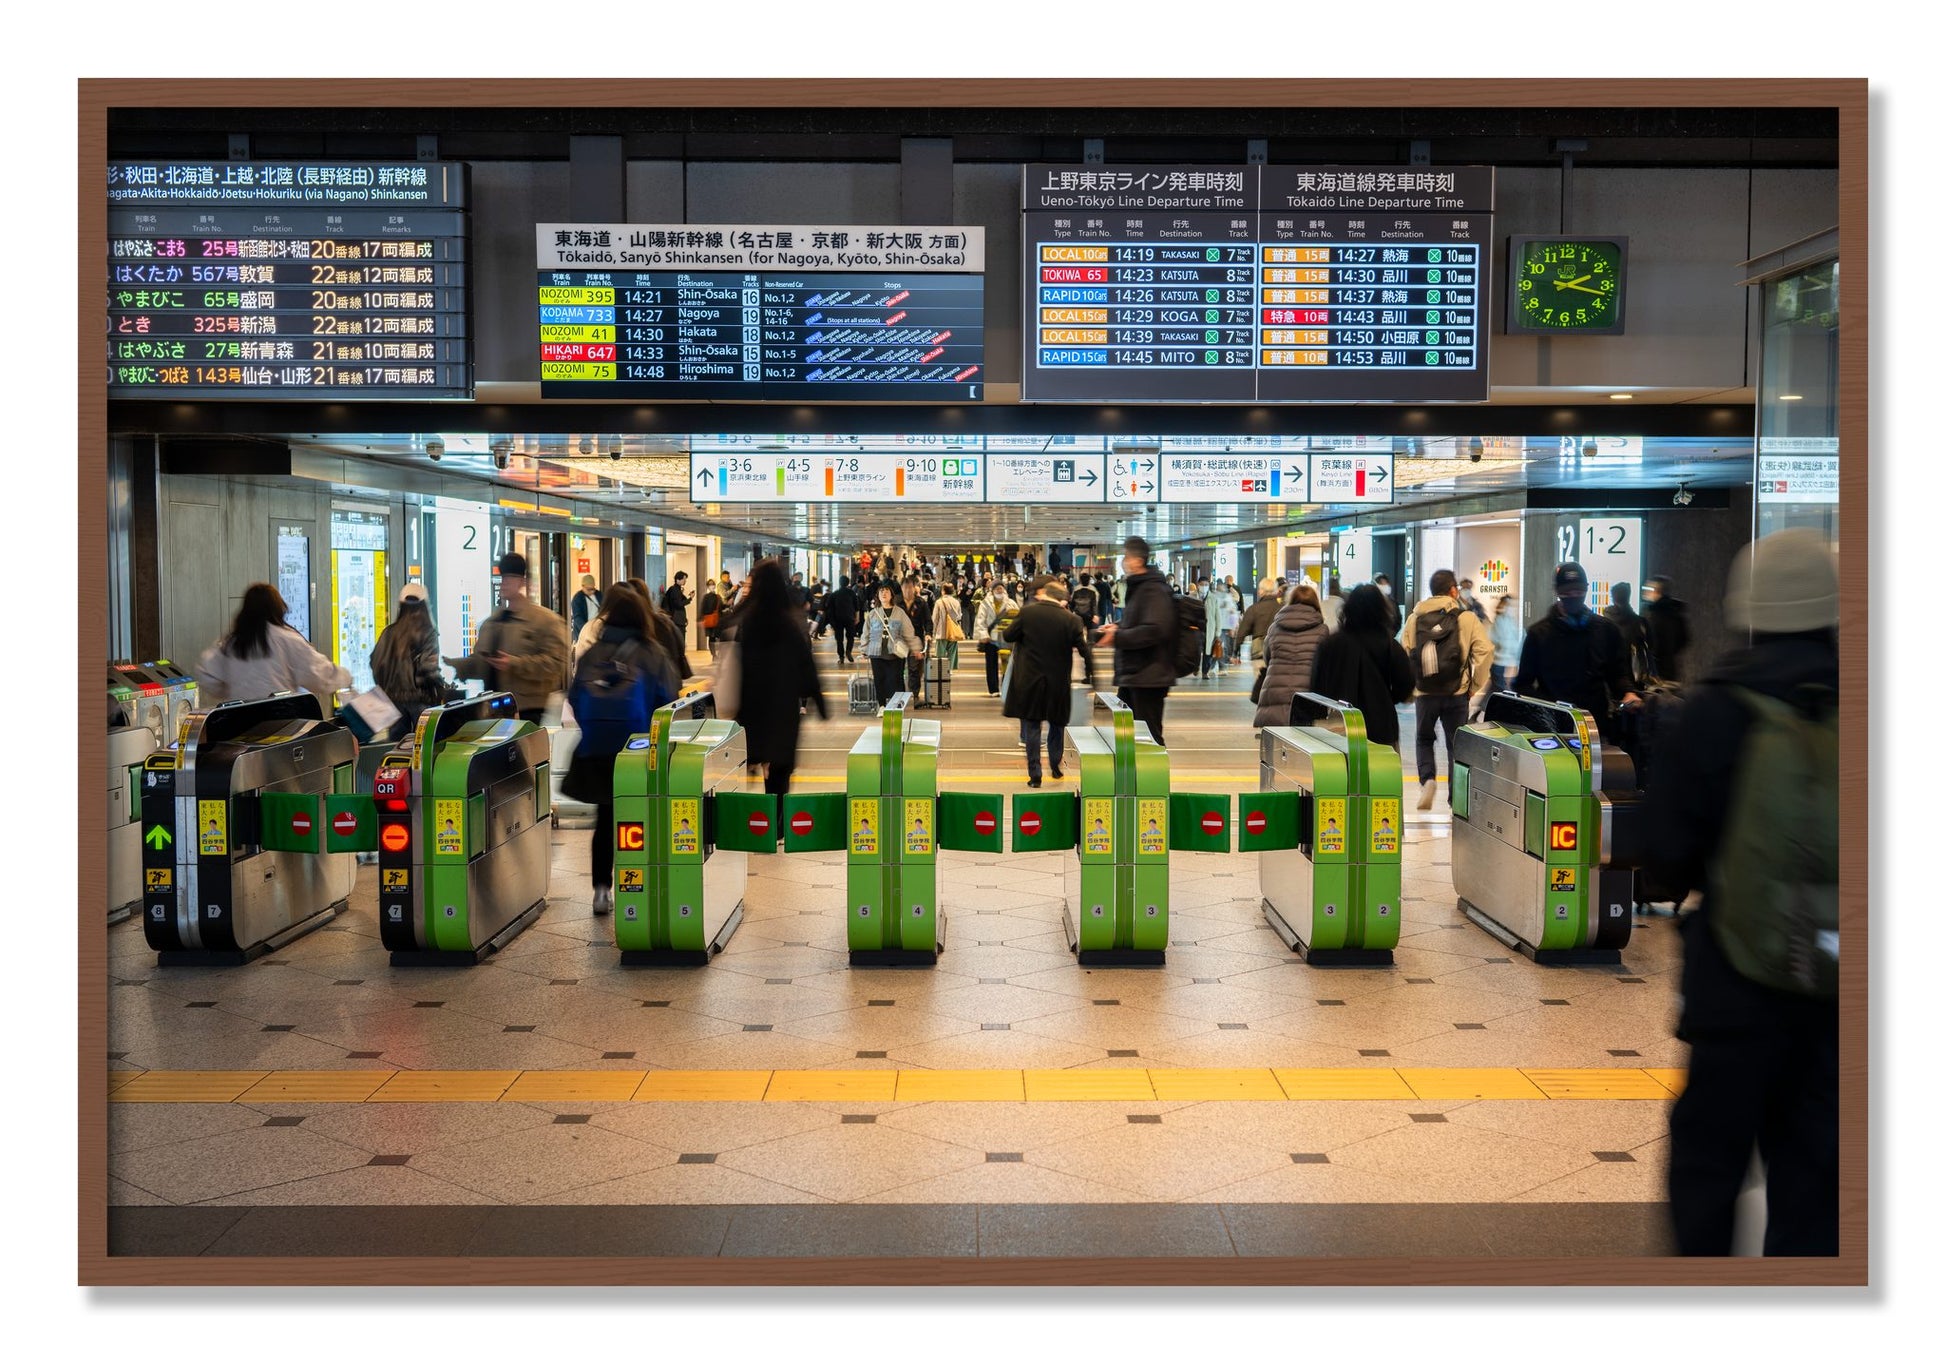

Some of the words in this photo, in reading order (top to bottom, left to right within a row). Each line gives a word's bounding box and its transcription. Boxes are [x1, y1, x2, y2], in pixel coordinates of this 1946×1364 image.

[1041, 171, 1243, 192] 上野東京ライン発車時刻
[1297, 173, 1454, 192] 東海道線発車時刻
[305, 189, 323, 201] (via
[326, 189, 368, 201] Nagano)
[371, 189, 427, 200] Shinkansen
[1041, 195, 1115, 209] Ueno-Tōkyō
[1119, 196, 1144, 207] Line
[1148, 196, 1210, 209] Departure
[1214, 196, 1244, 207] Time
[1287, 196, 1335, 207] Tōkaidō
[1339, 196, 1364, 207] Line
[1369, 196, 1430, 209] Departure
[1435, 197, 1464, 207] Time
[253, 225, 292, 233] Destination
[557, 251, 617, 264] Tōkaidō,
[620, 251, 661, 265] Sanyō
[665, 251, 743, 263] Shinkansen
[749, 252, 774, 265] (for
[778, 253, 833, 266] Nagoya,
[838, 252, 881, 266] Kyōto,
[885, 252, 965, 266] Shin-Ōsaka)
[1115, 249, 1154, 261] 14:19
[1161, 251, 1199, 259] TAKASAKI
[1272, 250, 1296, 262] 普通
[1337, 250, 1375, 262] 14:27
[1382, 250, 1409, 262] 熱海
[1560, 248, 1575, 258] 12
[1582, 252, 1587, 262] 1
[1594, 263, 1603, 272] 2
[115, 266, 183, 282] はくたか
[191, 265, 240, 282] 567号
[239, 265, 274, 283] 敦賀
[1044, 270, 1081, 280] TOKIWA
[1087, 270, 1101, 280] 65
[1115, 269, 1154, 282] 14:23
[1161, 271, 1199, 280] KATSUTA
[1337, 270, 1375, 282] 14:30
[1382, 270, 1407, 283] 品川
[1522, 280, 1532, 290] 9
[1601, 280, 1610, 290] 3
[117, 291, 185, 308] やまびこ
[204, 291, 240, 308] 65号
[240, 291, 275, 309] 盛岡
[541, 289, 583, 299] NOZOMI
[586, 290, 612, 303] 395
[625, 290, 661, 303] 14:21
[678, 289, 737, 299] Shin-Ōsaka
[765, 294, 795, 303] No.1,2
[1115, 290, 1154, 302] 14:26
[1161, 291, 1199, 301] KATSUTA
[1337, 291, 1374, 303] 14:37
[1382, 290, 1408, 303] 熱海
[542, 308, 583, 317] KODAMA
[587, 309, 613, 322] 733
[625, 309, 662, 322] 14:27
[678, 308, 720, 319] Nagoya
[1115, 310, 1154, 323] 14:29
[1161, 311, 1199, 322] KOGA
[1271, 311, 1296, 323] 特急
[1336, 311, 1374, 323] 14:43
[1382, 312, 1407, 324] 品川
[1560, 312, 1569, 322] 6
[118, 316, 151, 333] とき
[194, 316, 240, 333] 325号
[240, 315, 276, 334] 新潟
[542, 327, 584, 336] NOZOMI
[592, 328, 607, 340] 41
[625, 328, 664, 341] 14:30
[679, 327, 717, 337] Hakata
[1115, 331, 1153, 343] 14:39
[1161, 333, 1199, 341] TAKASAKI
[1270, 332, 1295, 344] 普通
[1336, 332, 1374, 344] 14:50
[1381, 331, 1419, 344] 小田原
[118, 341, 186, 358] はやぶさ
[205, 342, 240, 358] 27号
[240, 341, 294, 360] 新青森
[544, 345, 583, 354] HIKARI
[587, 346, 613, 359] 647
[626, 347, 664, 360] 14:33
[679, 345, 738, 356] Shin-Ōsaka
[765, 350, 796, 359] No.1-5
[1115, 351, 1153, 363] 14:45
[1161, 352, 1195, 362] MITO
[1336, 352, 1373, 364] 14:53
[1381, 352, 1406, 365] 品川
[196, 367, 241, 383] 143号
[543, 364, 584, 373] NOZOMI
[593, 365, 608, 377] 75
[626, 365, 664, 378] 14:48
[679, 364, 734, 374] Hiroshima
[1321, 460, 1352, 469] 京葉線
[836, 474, 886, 482] 上野東京ライン
[943, 480, 974, 489] 新幹線
[463, 526, 477, 549] 2
[1345, 544, 1356, 559] 4
[1480, 585, 1508, 593] GRANSTA
[377, 783, 395, 795] QR
[619, 825, 644, 848] IC
[1553, 826, 1575, 848] IC
[155, 906, 161, 915] 8
[211, 906, 217, 915] 7
[393, 906, 399, 915] 7
[446, 907, 453, 916] 6
[627, 907, 634, 916] 6
[682, 906, 688, 915] 5
[861, 906, 868, 916] 5
[914, 906, 921, 915] 4
[1095, 906, 1101, 915] 4
[1148, 906, 1155, 915] 3
[1327, 906, 1334, 914] 3
[1380, 906, 1387, 915] 2
[1559, 906, 1566, 915] 2
[1613, 906, 1619, 914] 1
